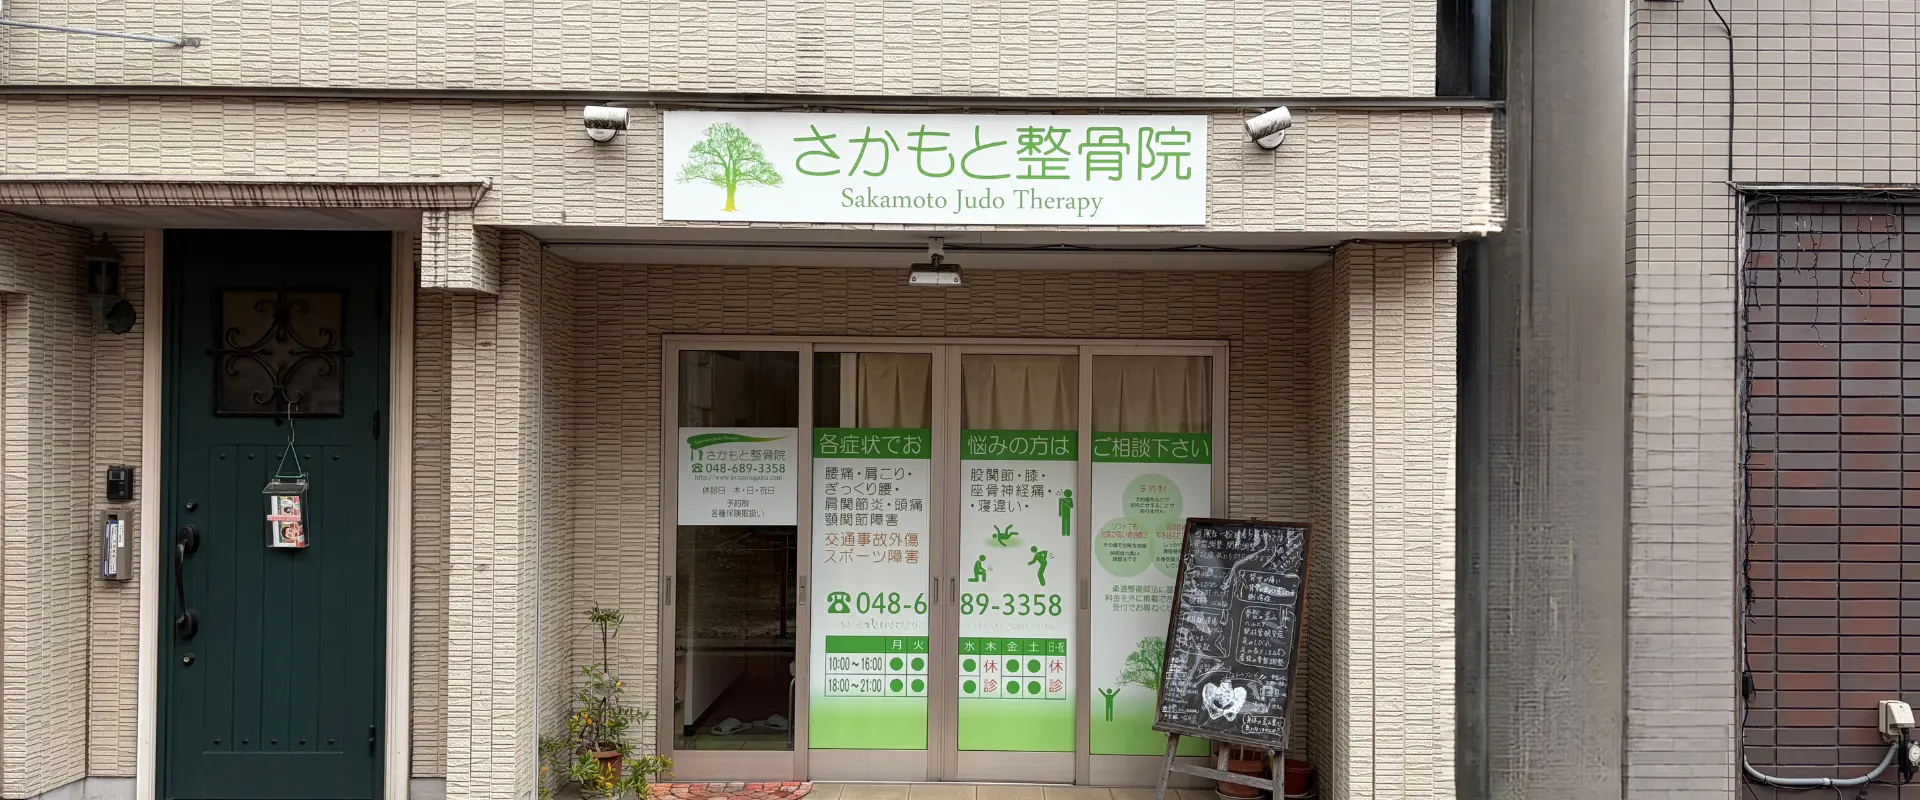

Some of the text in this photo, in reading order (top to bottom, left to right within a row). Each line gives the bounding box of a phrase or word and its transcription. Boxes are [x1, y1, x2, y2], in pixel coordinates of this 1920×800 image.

[793, 124, 1192, 181] さかもと整骨院
[841, 187, 1104, 218] Sakamoto Judo Therapy
[819, 433, 922, 455] 各症状でお
[967, 435, 1070, 455] 悩みの方は
[1094, 437, 1209, 458] ご相談下さい
[706, 450, 786, 462] さかもと整骨院
[706, 463, 786, 473] 048-689-3358
[824, 497, 923, 512] 肩関節炎・頭痛
[824, 531, 919, 547] 交通事故外傷
[824, 548, 919, 564] スポーツ障害
[856, 591, 928, 615] 048-6
[960, 592, 1062, 616] 89-3358
[891, 639, 902, 650] 月
[913, 640, 924, 650] 火
[963, 641, 975, 651] 水
[985, 641, 997, 652] 木
[1006, 641, 1018, 652] 金
[1028, 641, 1039, 652] 土
